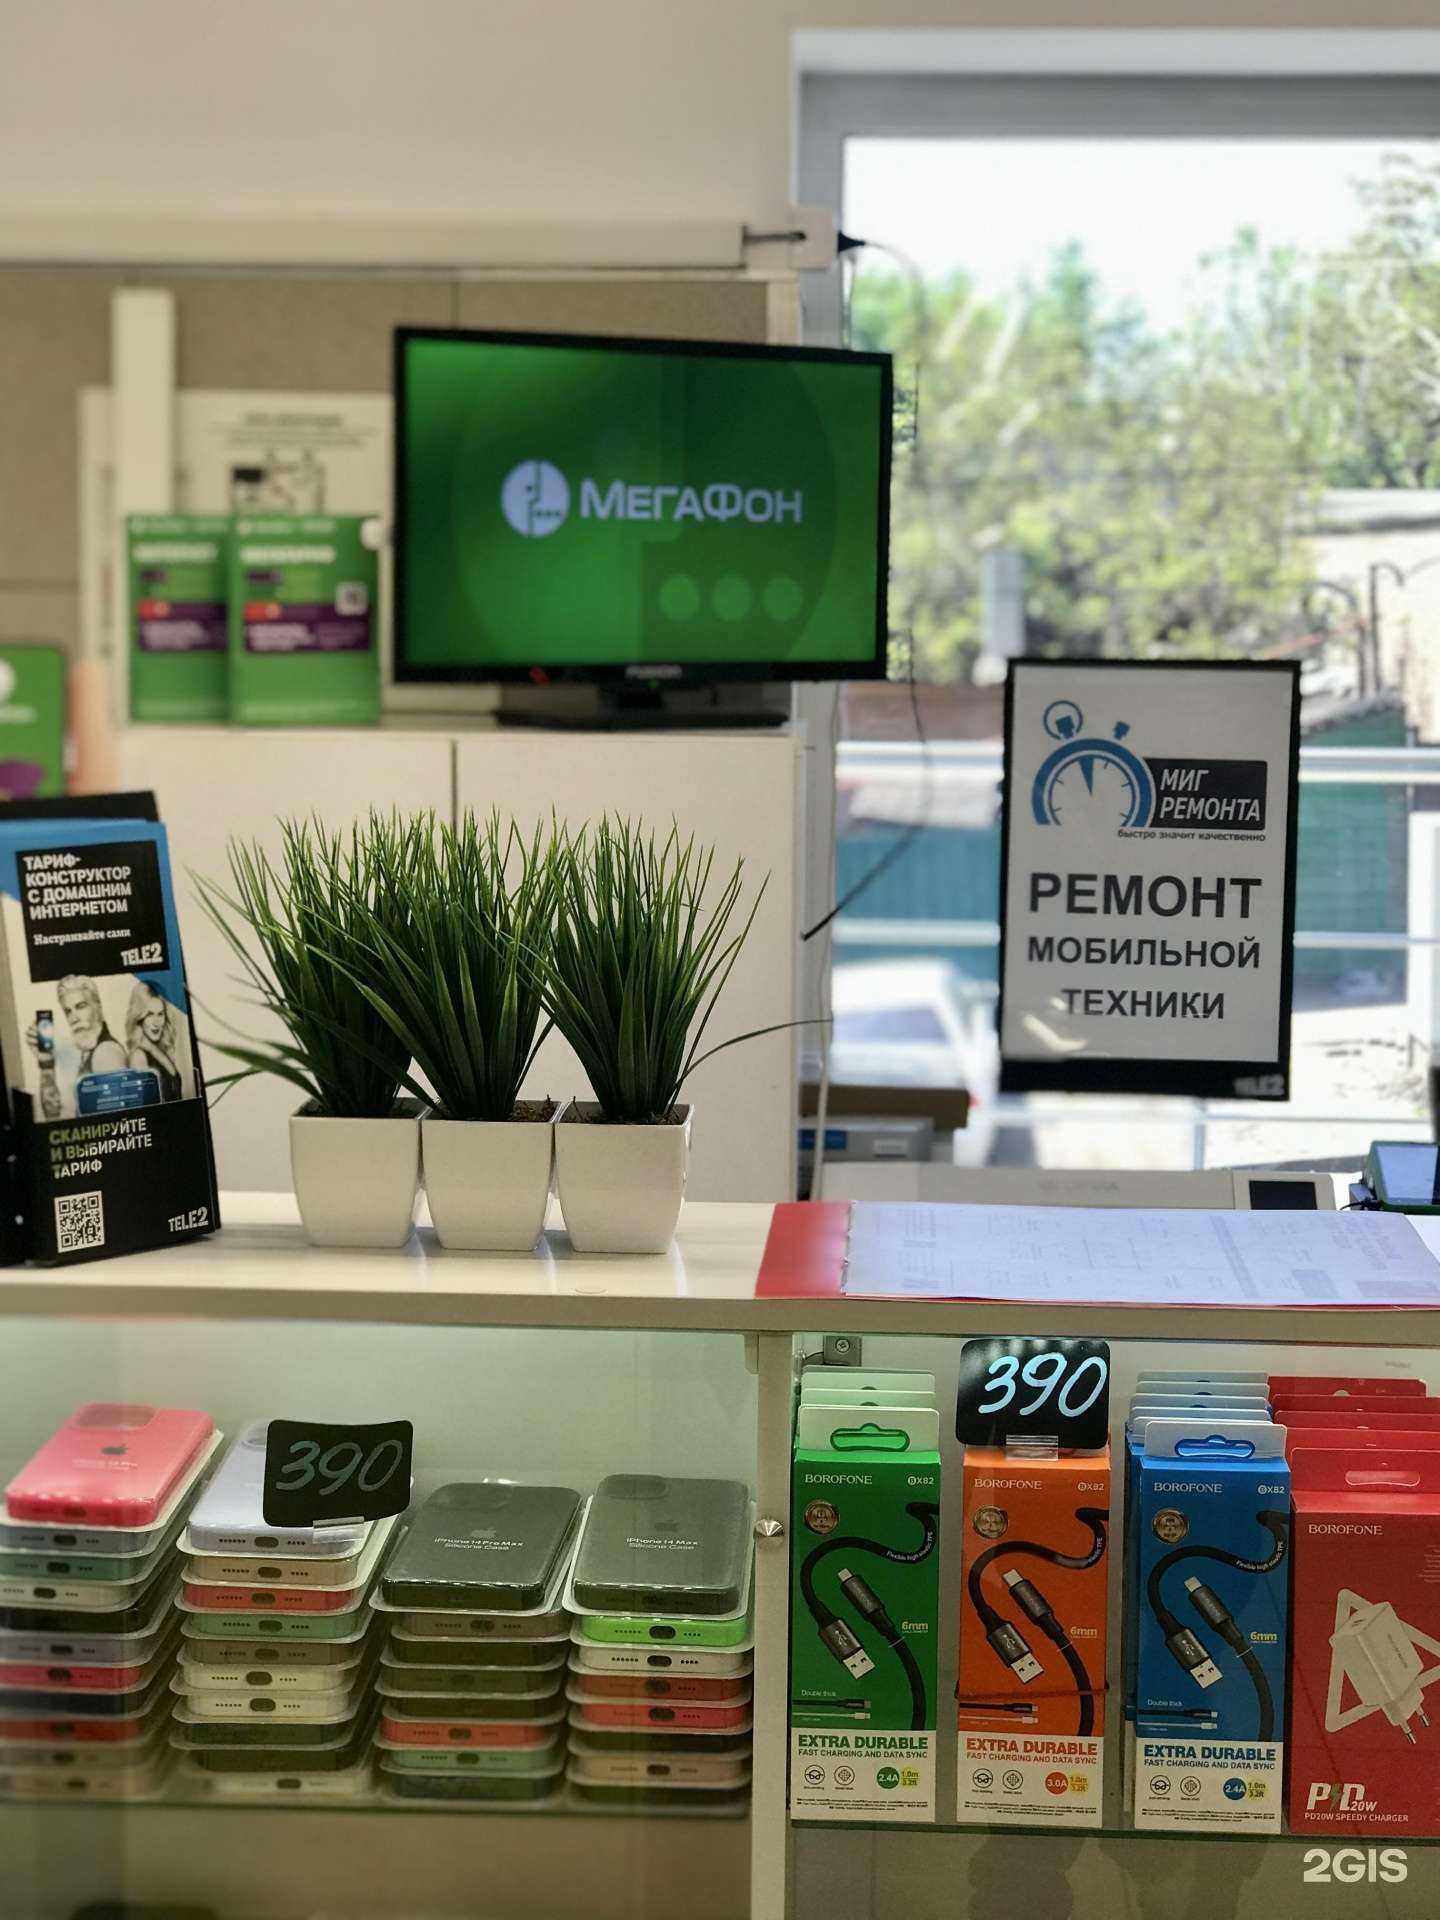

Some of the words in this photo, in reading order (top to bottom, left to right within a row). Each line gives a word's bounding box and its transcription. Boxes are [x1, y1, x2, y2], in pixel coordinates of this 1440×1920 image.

[1160, 768, 1209, 791] МИГ
[1160, 797, 1260, 821] РЕМОНТА
[1118, 830, 1156, 840] быстро
[23, 853, 81, 871] ТАРИФ-
[25, 866, 131, 887] КОНСТРУКТОР
[28, 889, 40, 903] С
[43, 883, 132, 904] ДОМАШНИМ
[1030, 872, 1262, 918] РЕМОНТ
[30, 899, 128, 920] ИНТЕРНЕТОМ
[33, 930, 105, 946] Настраивайте
[106, 929, 131, 938] сами
[121, 942, 163, 966] TELE2
[1028, 936, 1260, 968] МОБИЛЬНОЙ
[1062, 989, 1225, 1019] ТЕХНИКИ
[50, 1117, 147, 1145] СКАНИРУЙТЕ
[51, 1147, 63, 1162] И
[66, 1134, 152, 1159] ВЫБИРАЙТЕ
[52, 1159, 103, 1179] ТАРИФ
[168, 1207, 209, 1232] TELE2
[978, 1353, 1107, 1417] 390
[276, 1437, 403, 1496] 390
[805, 1474, 873, 1485] BOROFONE
[974, 1478, 1042, 1490] BOROFONE
[1154, 1482, 1224, 1493] BOROFONE
[1309, 1524, 1383, 1535] BOROFONE
[902, 1621, 928, 1631] 6mm
[1070, 1626, 1097, 1636] 6mm
[1250, 1631, 1277, 1641] 6mm
[798, 1735, 850, 1748] EXTRA
[855, 1736, 928, 1749] DURABLE
[966, 1738, 1018, 1752] EXTRA
[1024, 1741, 1097, 1755] DURABLE
[820, 1750, 862, 1758] CHARGING
[990, 1753, 1032, 1761] CHARGING
[1144, 1744, 1196, 1758] EXTRA
[1201, 1747, 1276, 1760] DURABLE
[1166, 1760, 1209, 1768] CHARGING
[879, 1773, 899, 1782] 2.4A
[1047, 1778, 1067, 1787] 3.0A
[1225, 1784, 1245, 1793] 2.4A
[1351, 1801, 1377, 1811] 20W
[1336, 1813, 1367, 1821] SPEEDY
[1369, 1814, 1408, 1822] CHARGER
